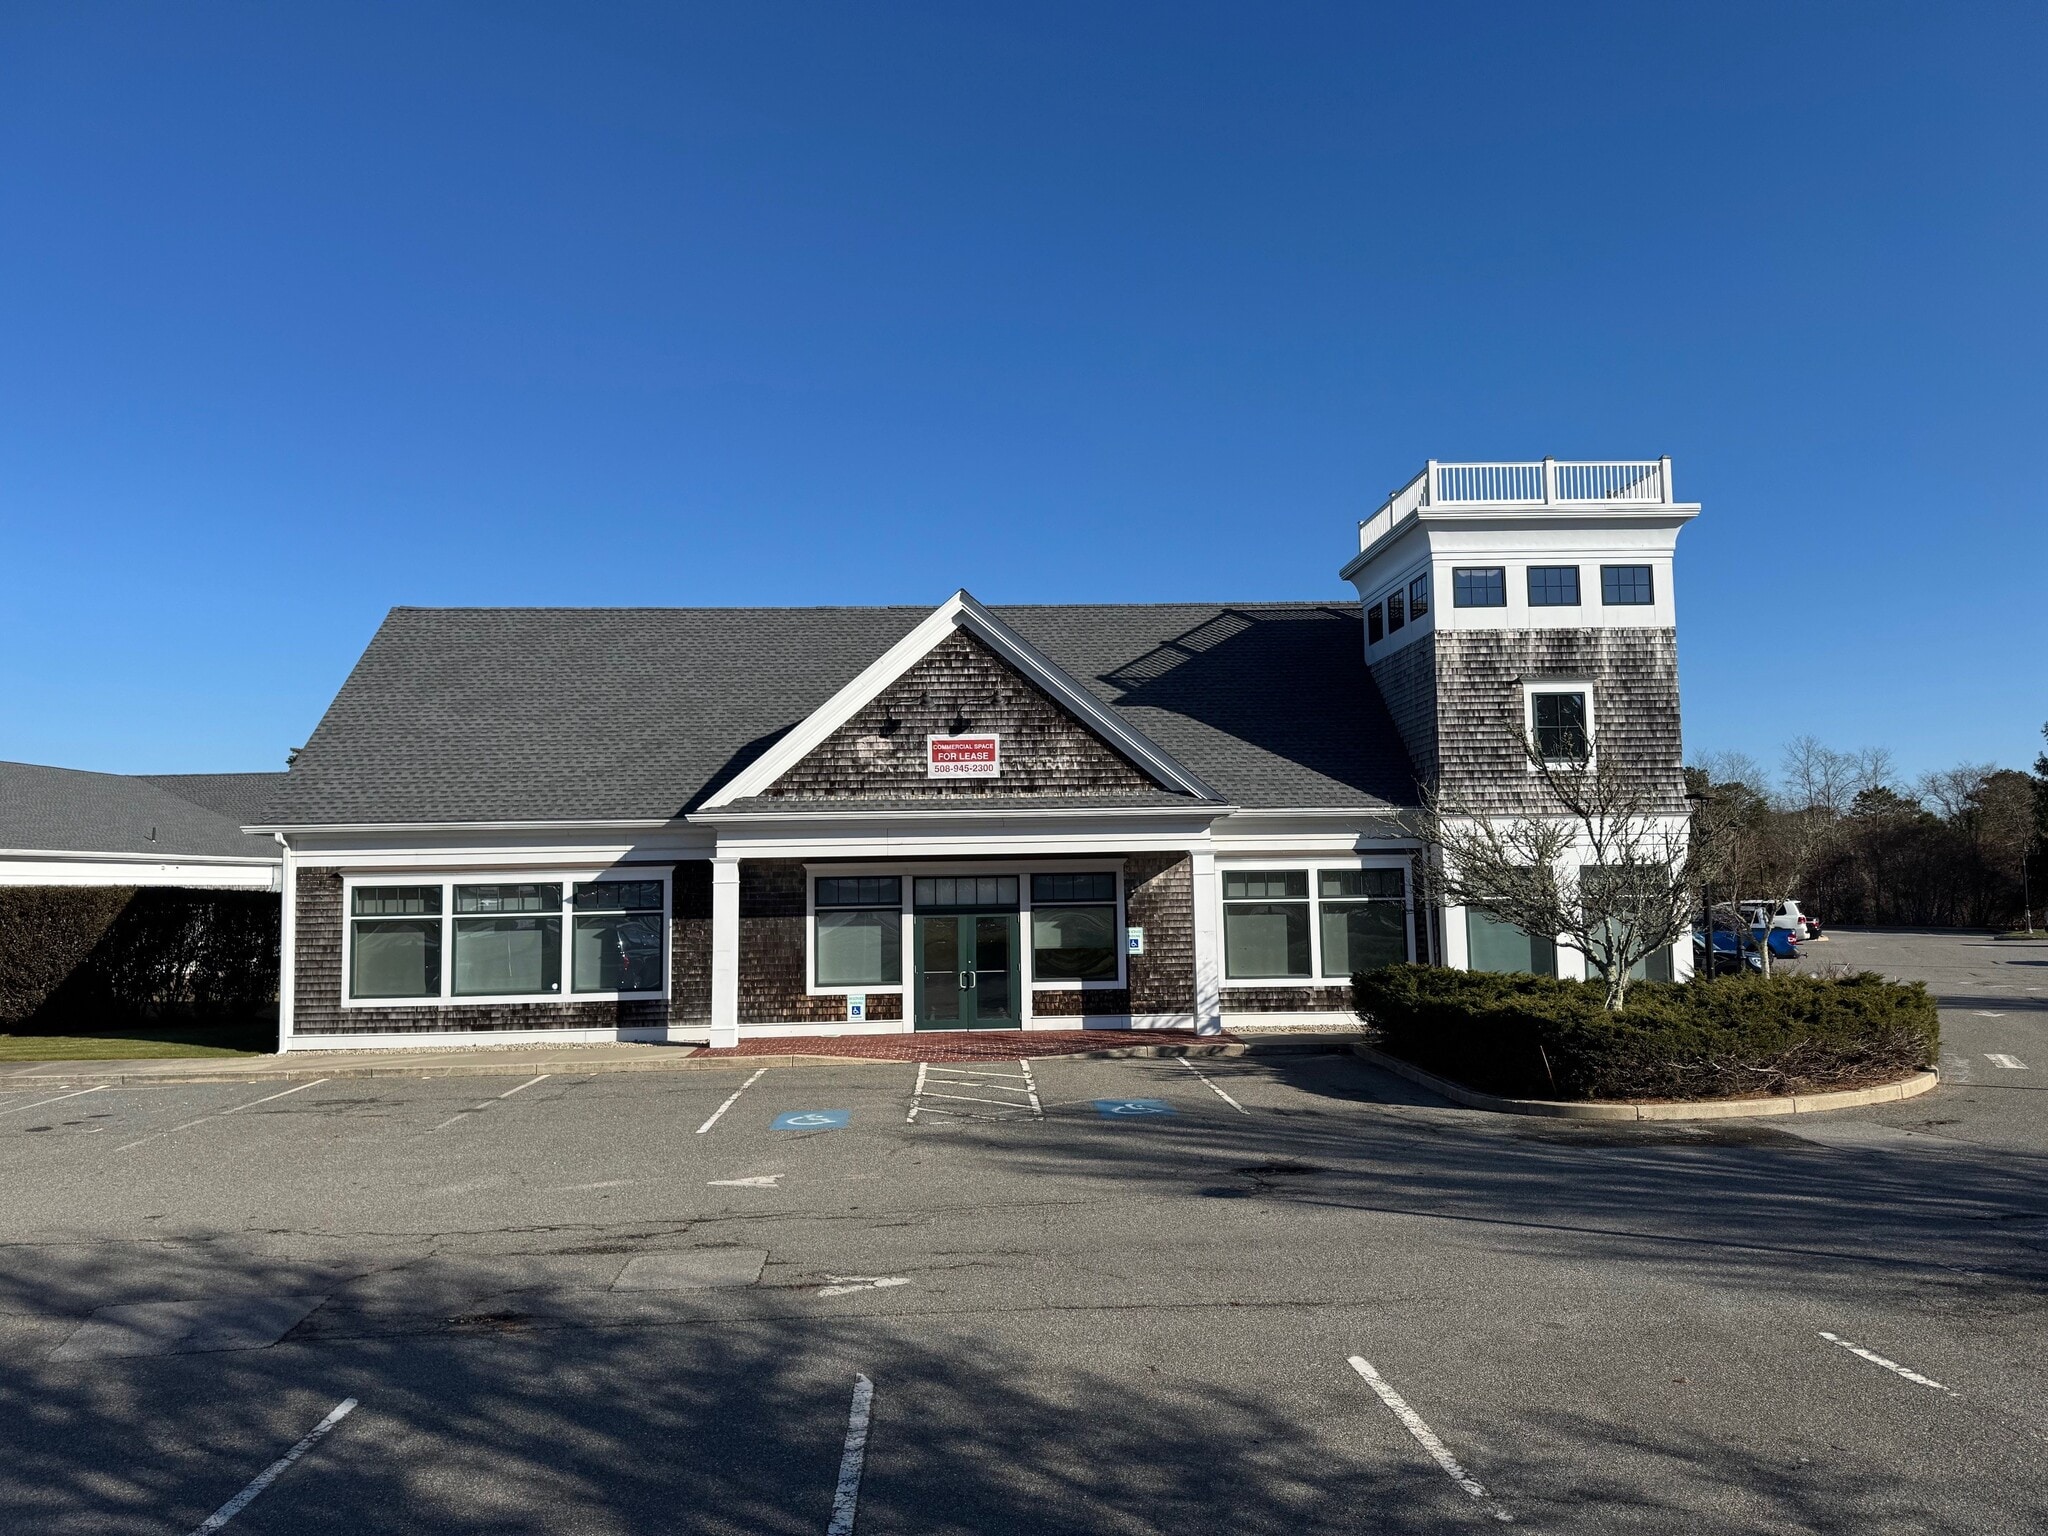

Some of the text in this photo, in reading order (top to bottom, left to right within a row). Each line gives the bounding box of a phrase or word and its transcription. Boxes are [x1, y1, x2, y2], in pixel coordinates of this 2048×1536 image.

[938, 752, 989, 761] FOR LEASE
[934, 764, 994, 773] 508-945-2300
